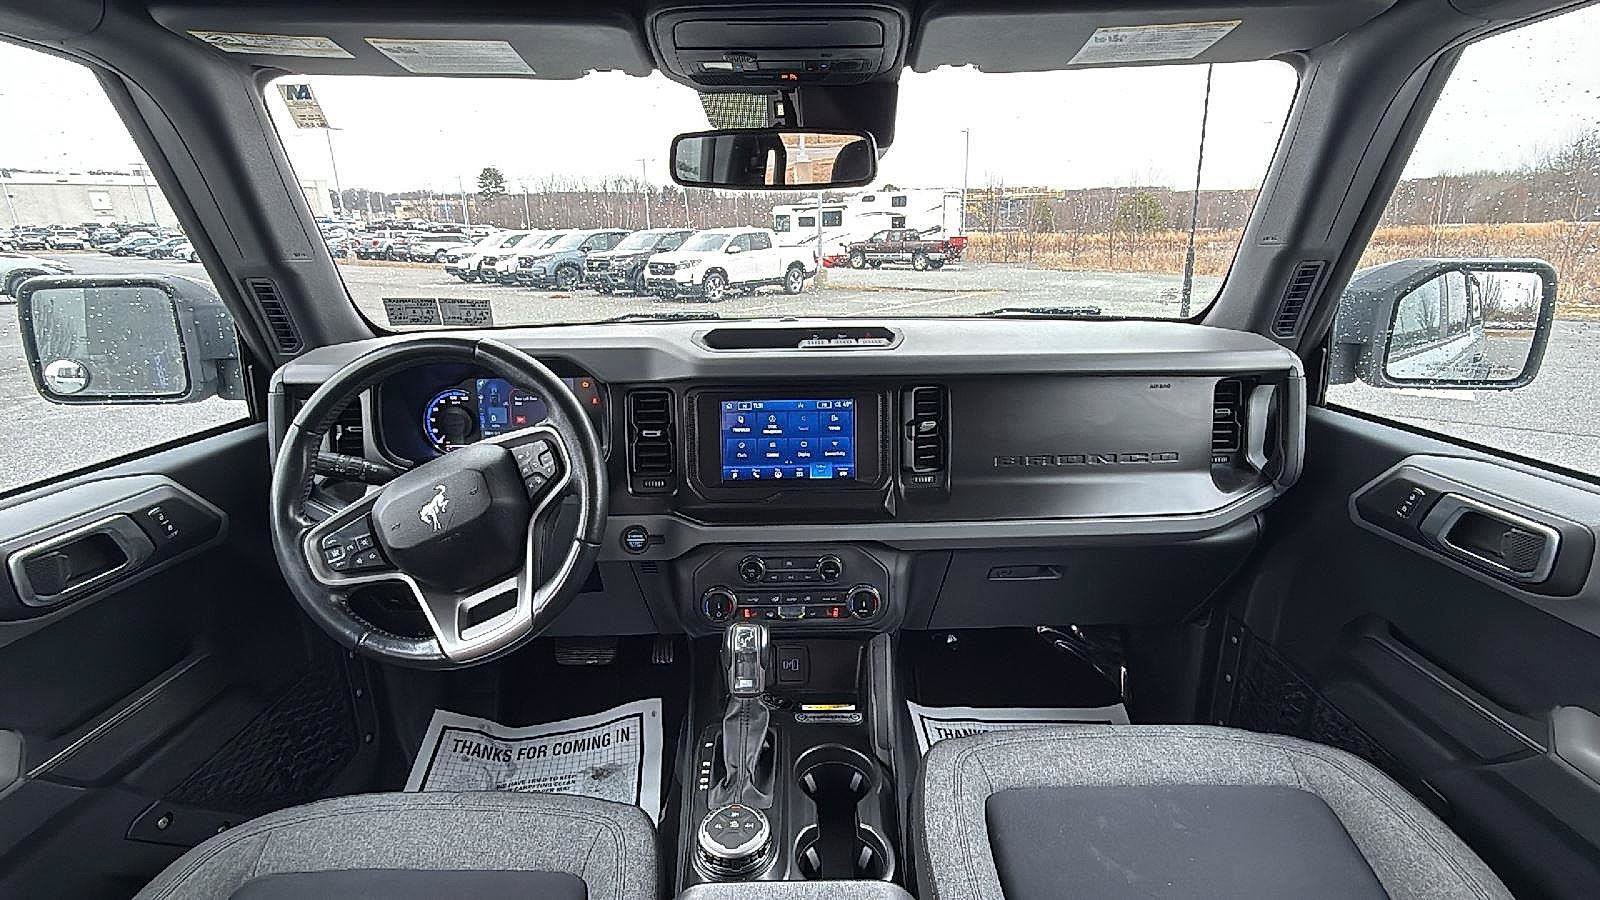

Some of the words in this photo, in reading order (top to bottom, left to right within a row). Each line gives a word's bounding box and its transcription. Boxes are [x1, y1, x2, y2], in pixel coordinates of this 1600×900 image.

[993, 452, 1179, 467] BRONCO
[453, 740, 513, 762] THANKS
[516, 744, 547, 761] FOR
[552, 733, 611, 756] COMING
[616, 727, 630, 743] IN
